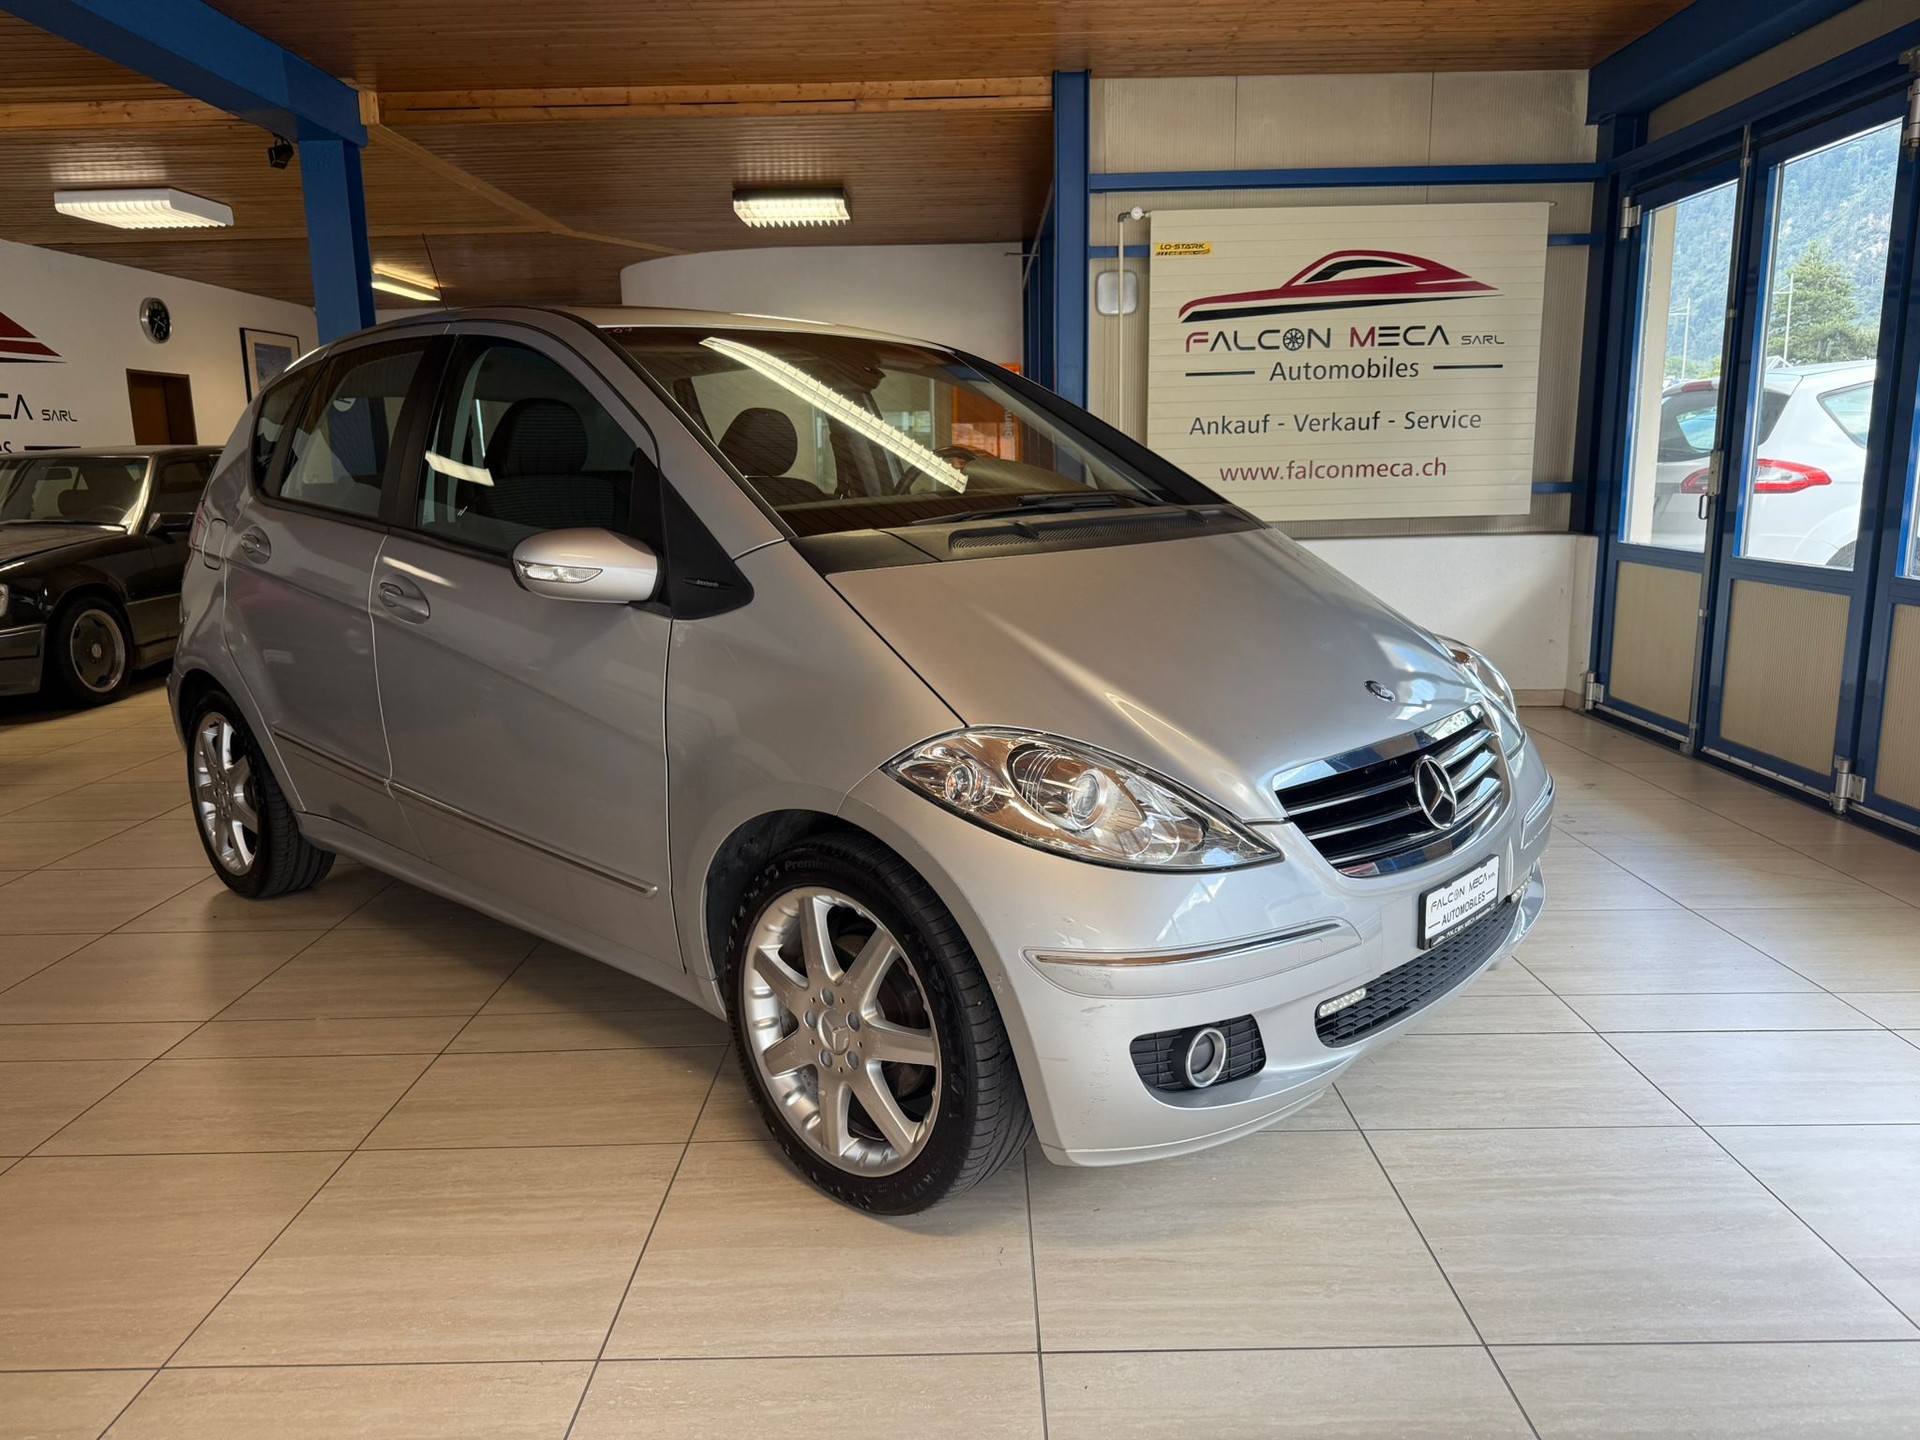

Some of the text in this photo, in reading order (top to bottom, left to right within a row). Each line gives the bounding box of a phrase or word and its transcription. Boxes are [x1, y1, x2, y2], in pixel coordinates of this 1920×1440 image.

[1185, 325, 1505, 352] FALCON MECA SARL
[1269, 356, 1419, 381] Automobiles
[41, 409, 78, 422] SARL
[1189, 414, 1271, 436] Ankauf
[1293, 411, 1381, 433] Verkauf
[1404, 410, 1482, 430] Service
[1219, 457, 1447, 482] www.falconmeca.ch
[1431, 886, 1466, 913] FALCON
[1469, 873, 1488, 891] MECA
[1441, 890, 1486, 927] AUTOMOBILES
